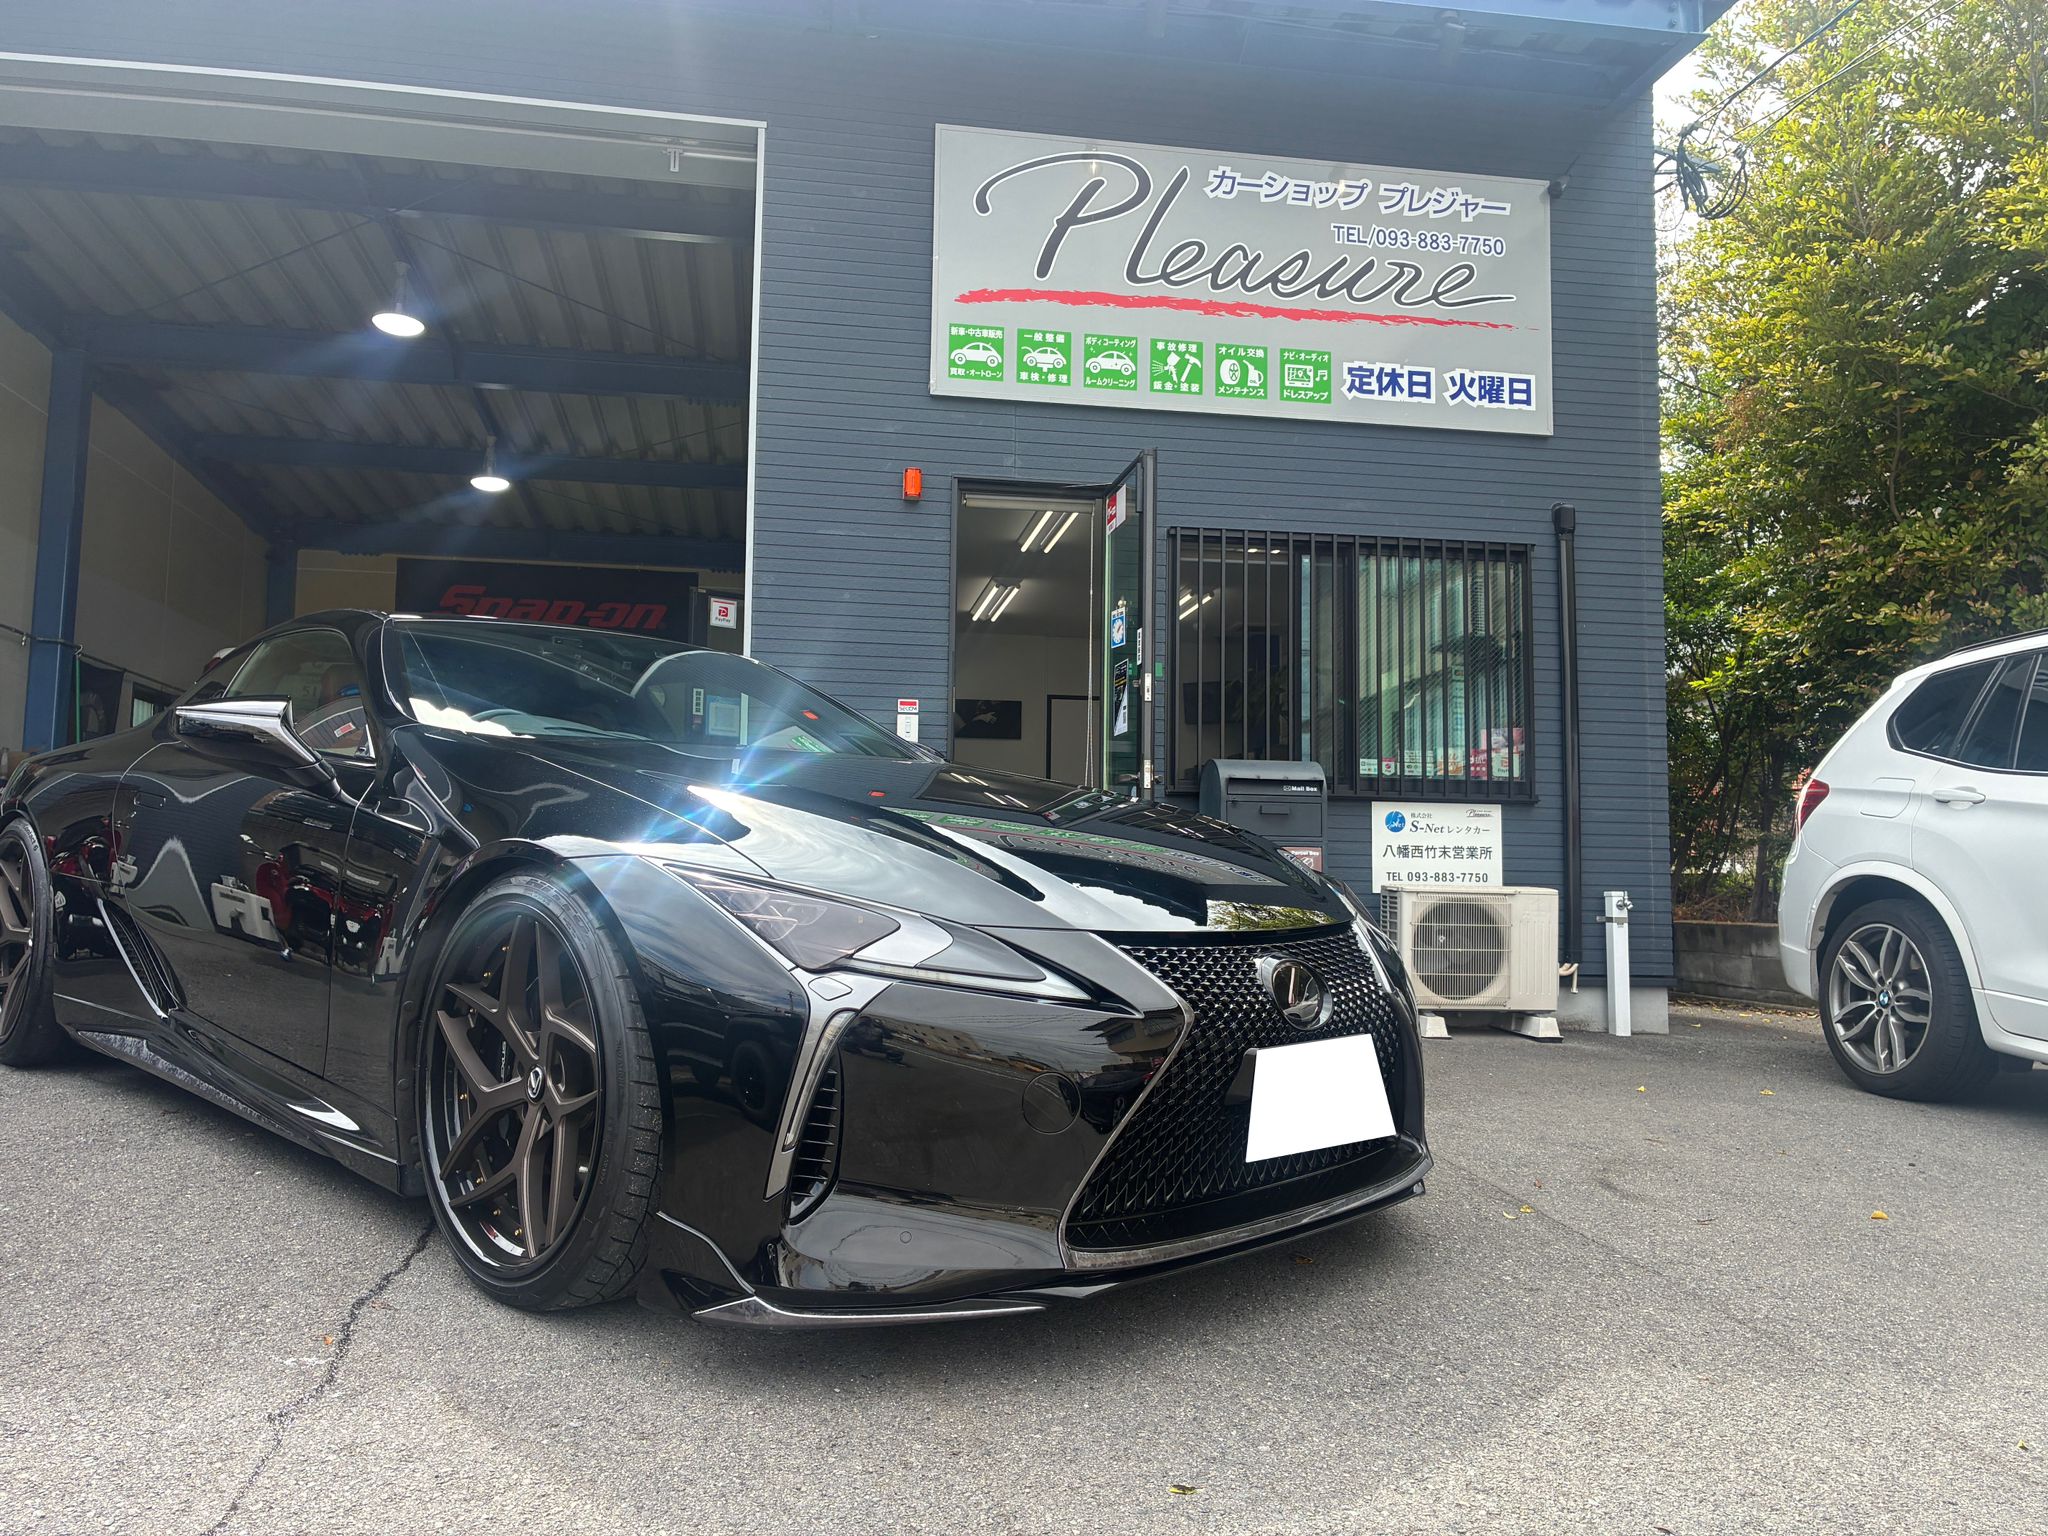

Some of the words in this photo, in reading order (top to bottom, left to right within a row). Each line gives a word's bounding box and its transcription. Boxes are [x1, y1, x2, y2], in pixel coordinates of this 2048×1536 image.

[1205, 166, 1371, 209] カーショップ
[1379, 184, 1509, 220] プレジャー
[976, 151, 1517, 309] Pleasure
[1332, 224, 1505, 256] TEL/093-883-7750
[1023, 333, 1065, 344] 一般整備
[1156, 341, 1198, 353] 事故修理
[1218, 386, 1265, 397] メンテナンス
[1345, 364, 1433, 400] 定休日
[1448, 371, 1533, 407] 火曜日
[1283, 389, 1329, 401] ドレスアップ
[1382, 844, 1493, 861] 八幡西竹末営業所
[1386, 872, 1403, 882] TEL
[1407, 872, 1489, 883] 093-883-7750
